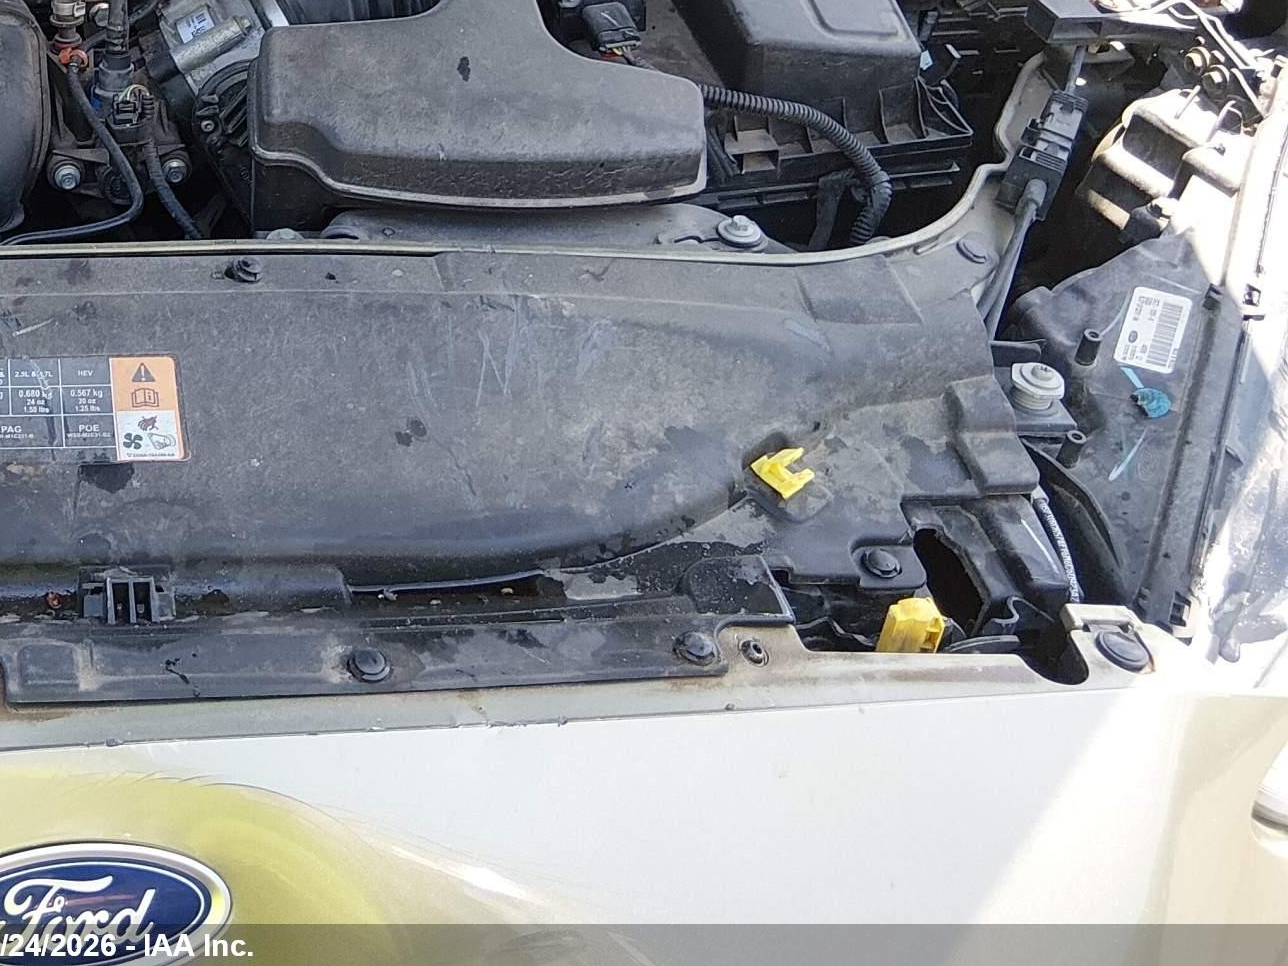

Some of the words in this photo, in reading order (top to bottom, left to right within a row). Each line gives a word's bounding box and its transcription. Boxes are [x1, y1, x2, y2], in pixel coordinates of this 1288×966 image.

[18, 389, 40, 398] 0.680
[70, 389, 91, 397] 0.567
[93, 389, 103, 398] kg
[0, 425, 22, 433] PAG
[78, 424, 100, 432] POE
